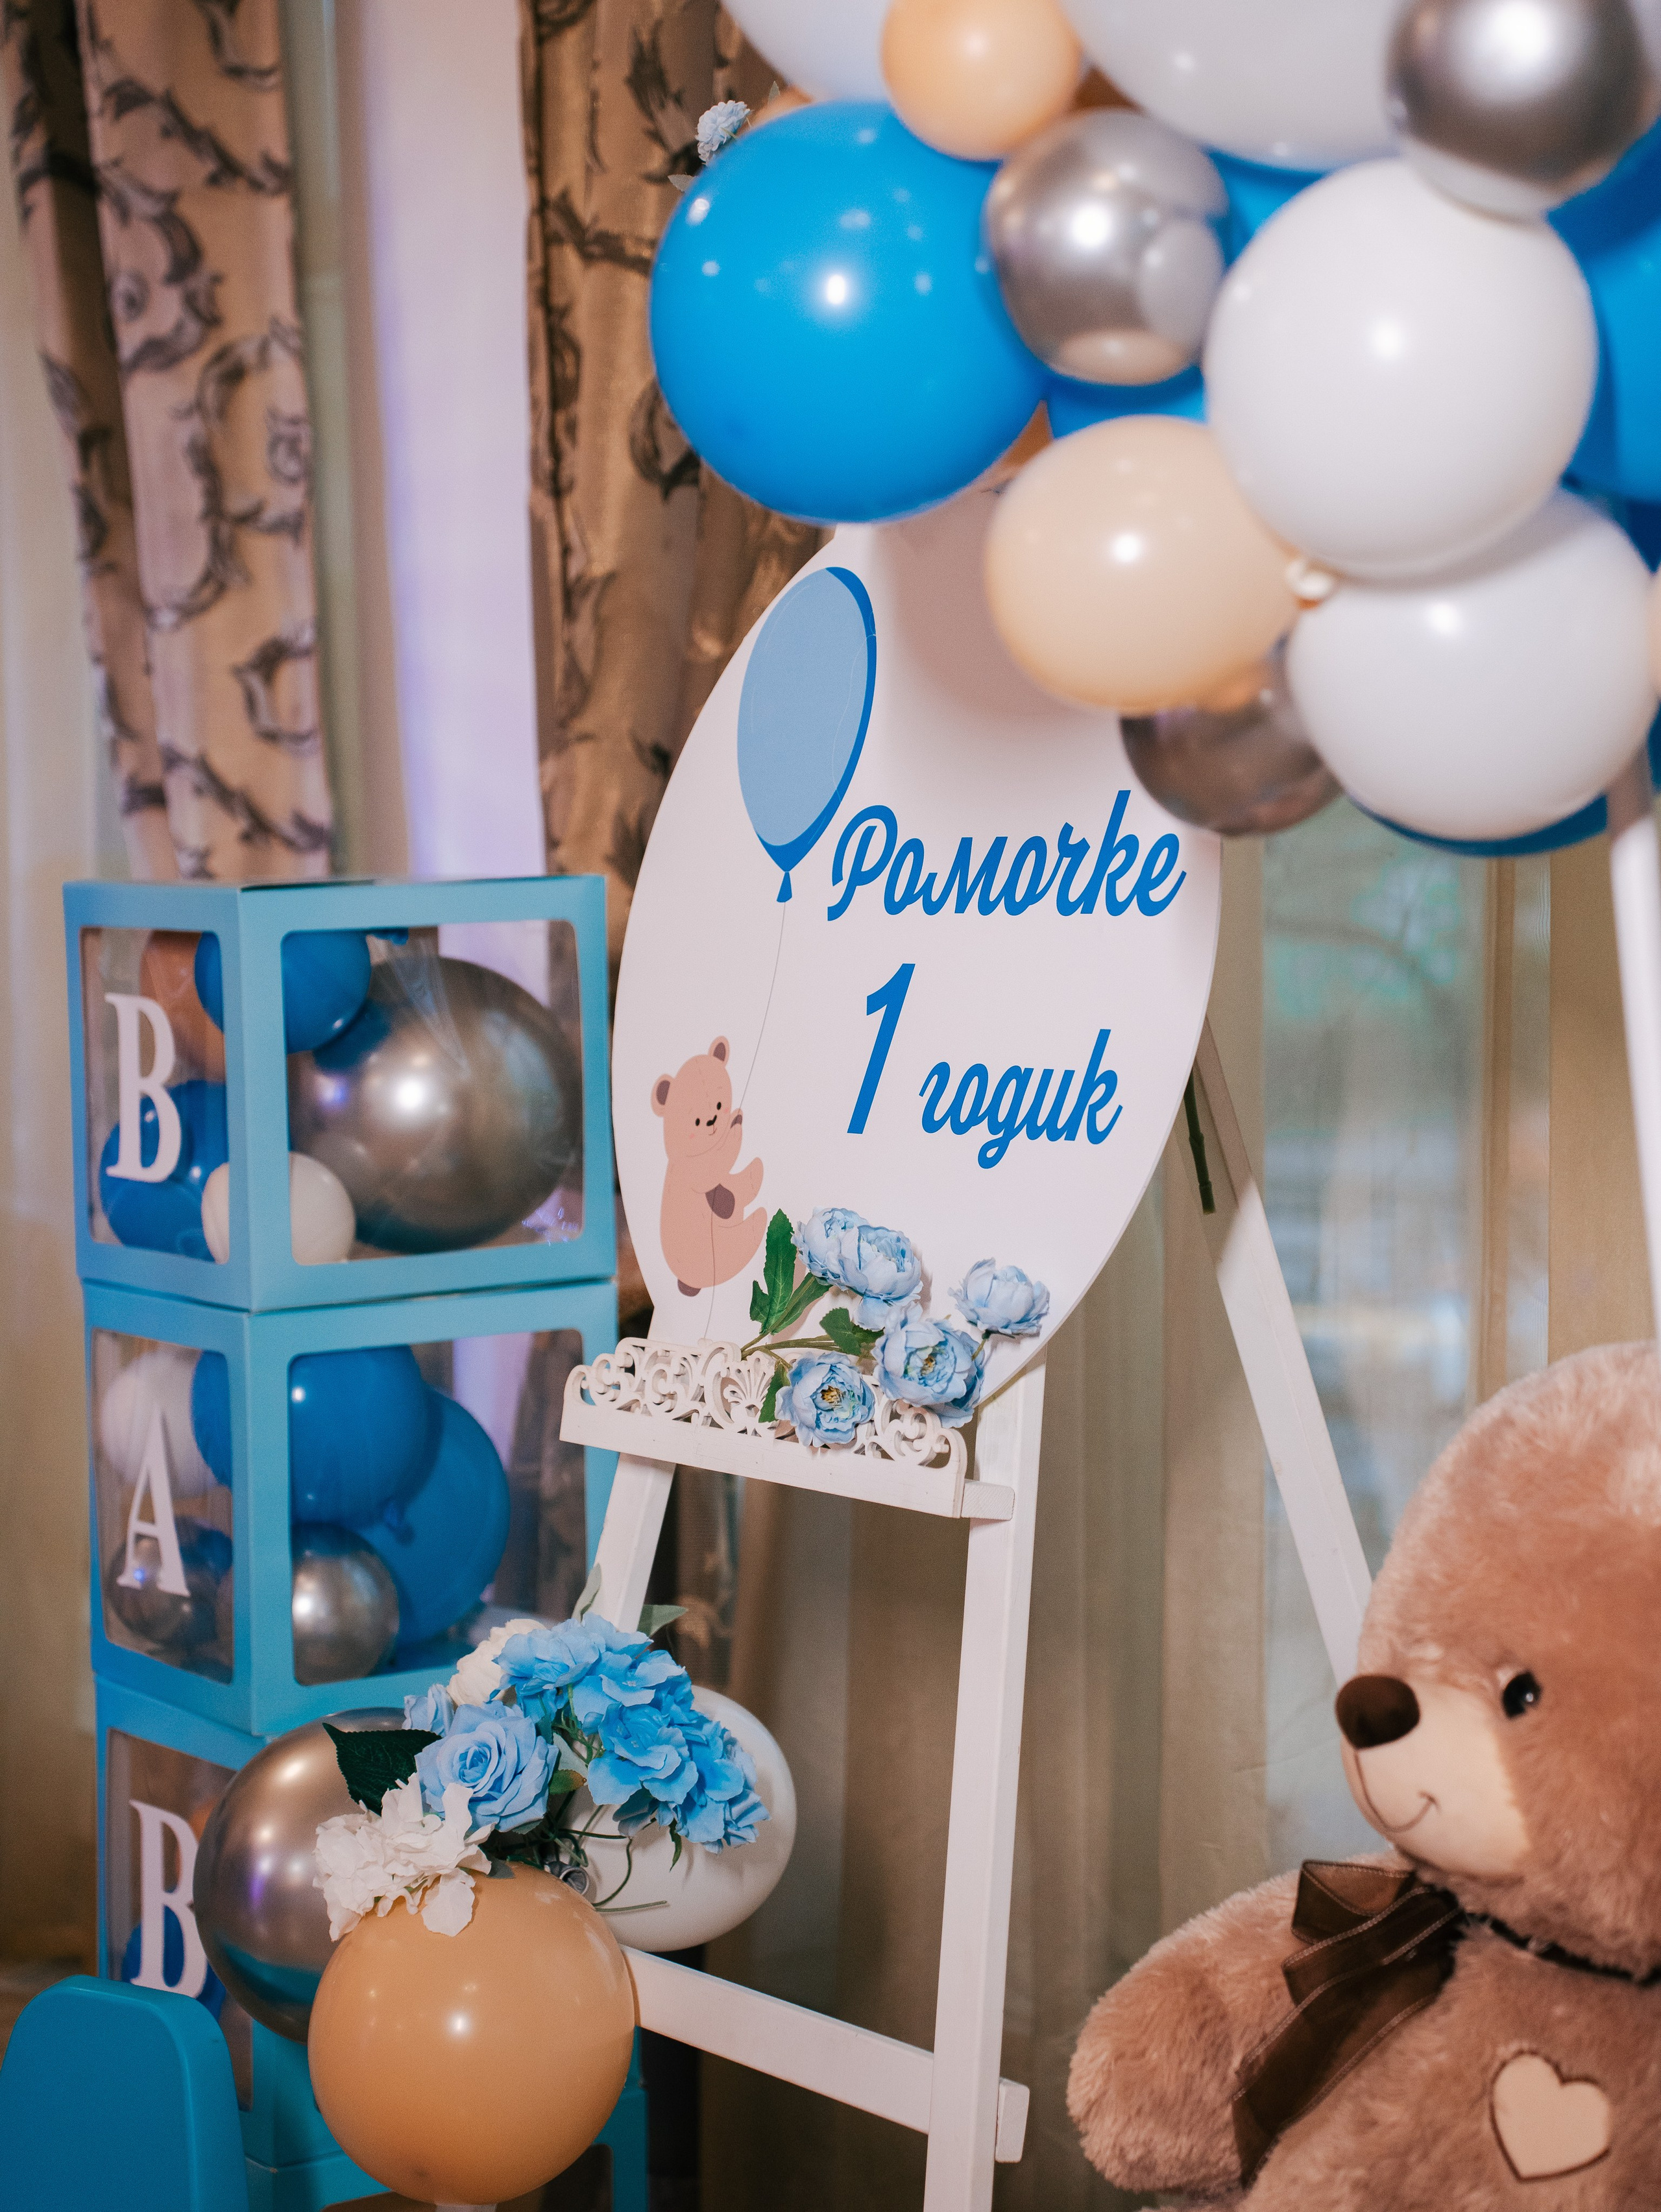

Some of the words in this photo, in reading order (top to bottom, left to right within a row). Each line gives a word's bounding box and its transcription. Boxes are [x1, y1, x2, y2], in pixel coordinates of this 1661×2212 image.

[827, 789, 1187, 921] Ромочке
[104, 992, 182, 1183] B
[847, 963, 915, 1135] 1
[919, 1029, 1123, 1169] годик
[117, 1400, 191, 1598] A
[129, 1799, 208, 1998] B
